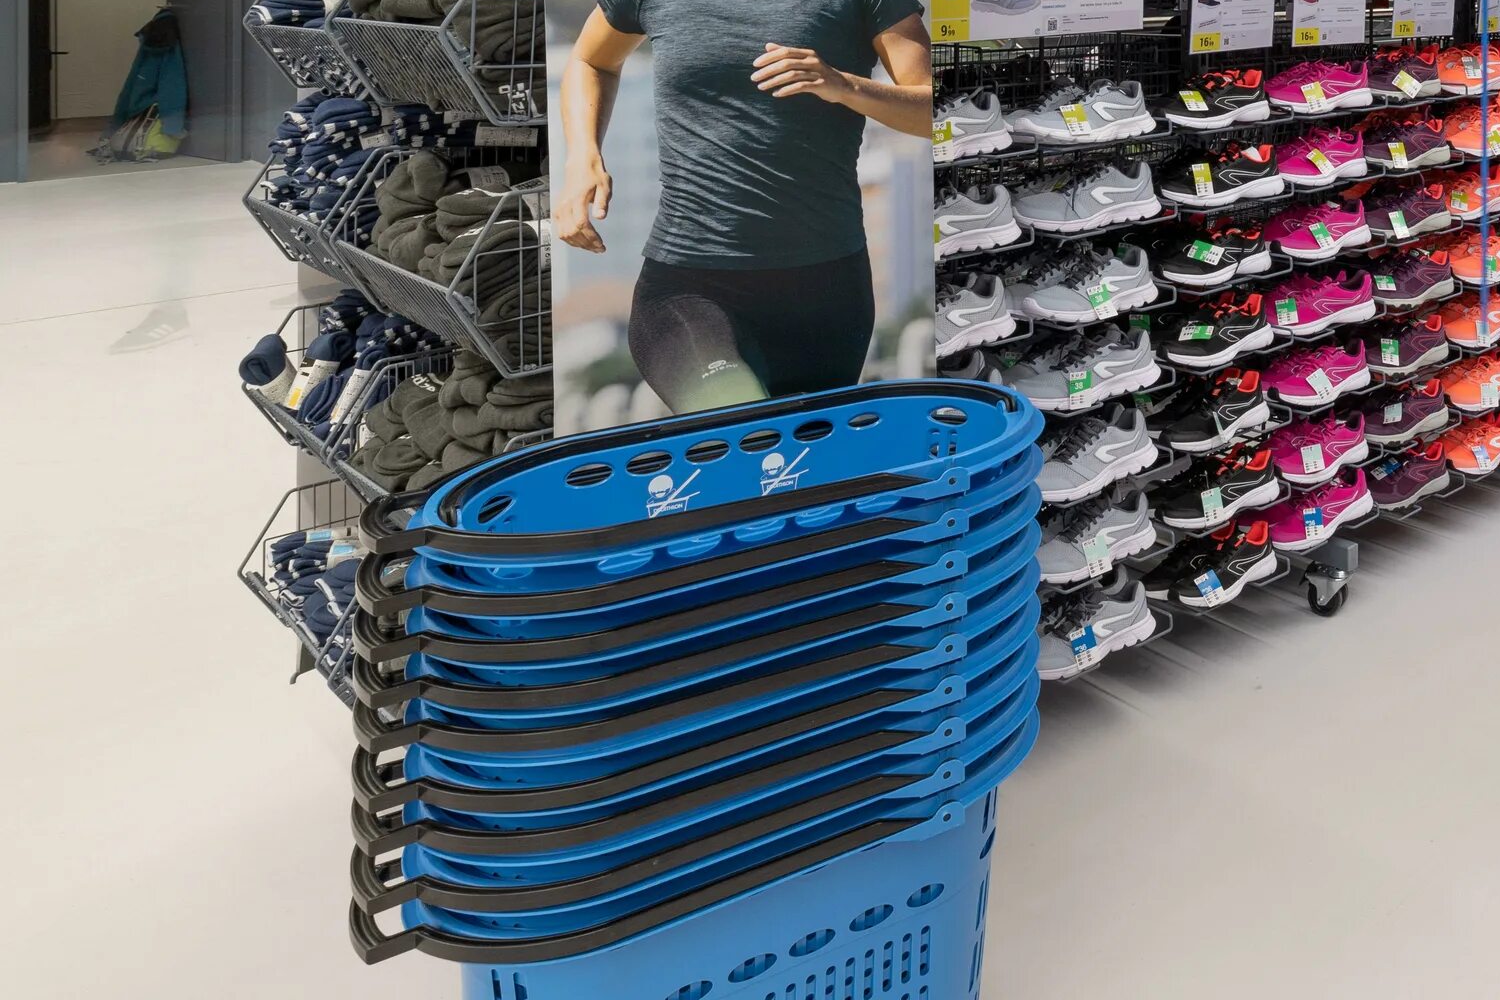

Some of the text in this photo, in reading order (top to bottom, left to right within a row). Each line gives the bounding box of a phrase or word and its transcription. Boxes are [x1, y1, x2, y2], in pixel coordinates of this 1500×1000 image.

[941, 24, 947, 37] 9
[1301, 31, 1309, 41] 16
[1199, 37, 1209, 47] 16
[935, 132, 945, 141] 39
[1074, 382, 1084, 390] 38
[766, 479, 794, 489] DATHLON
[653, 503, 683, 513] DATHLON
